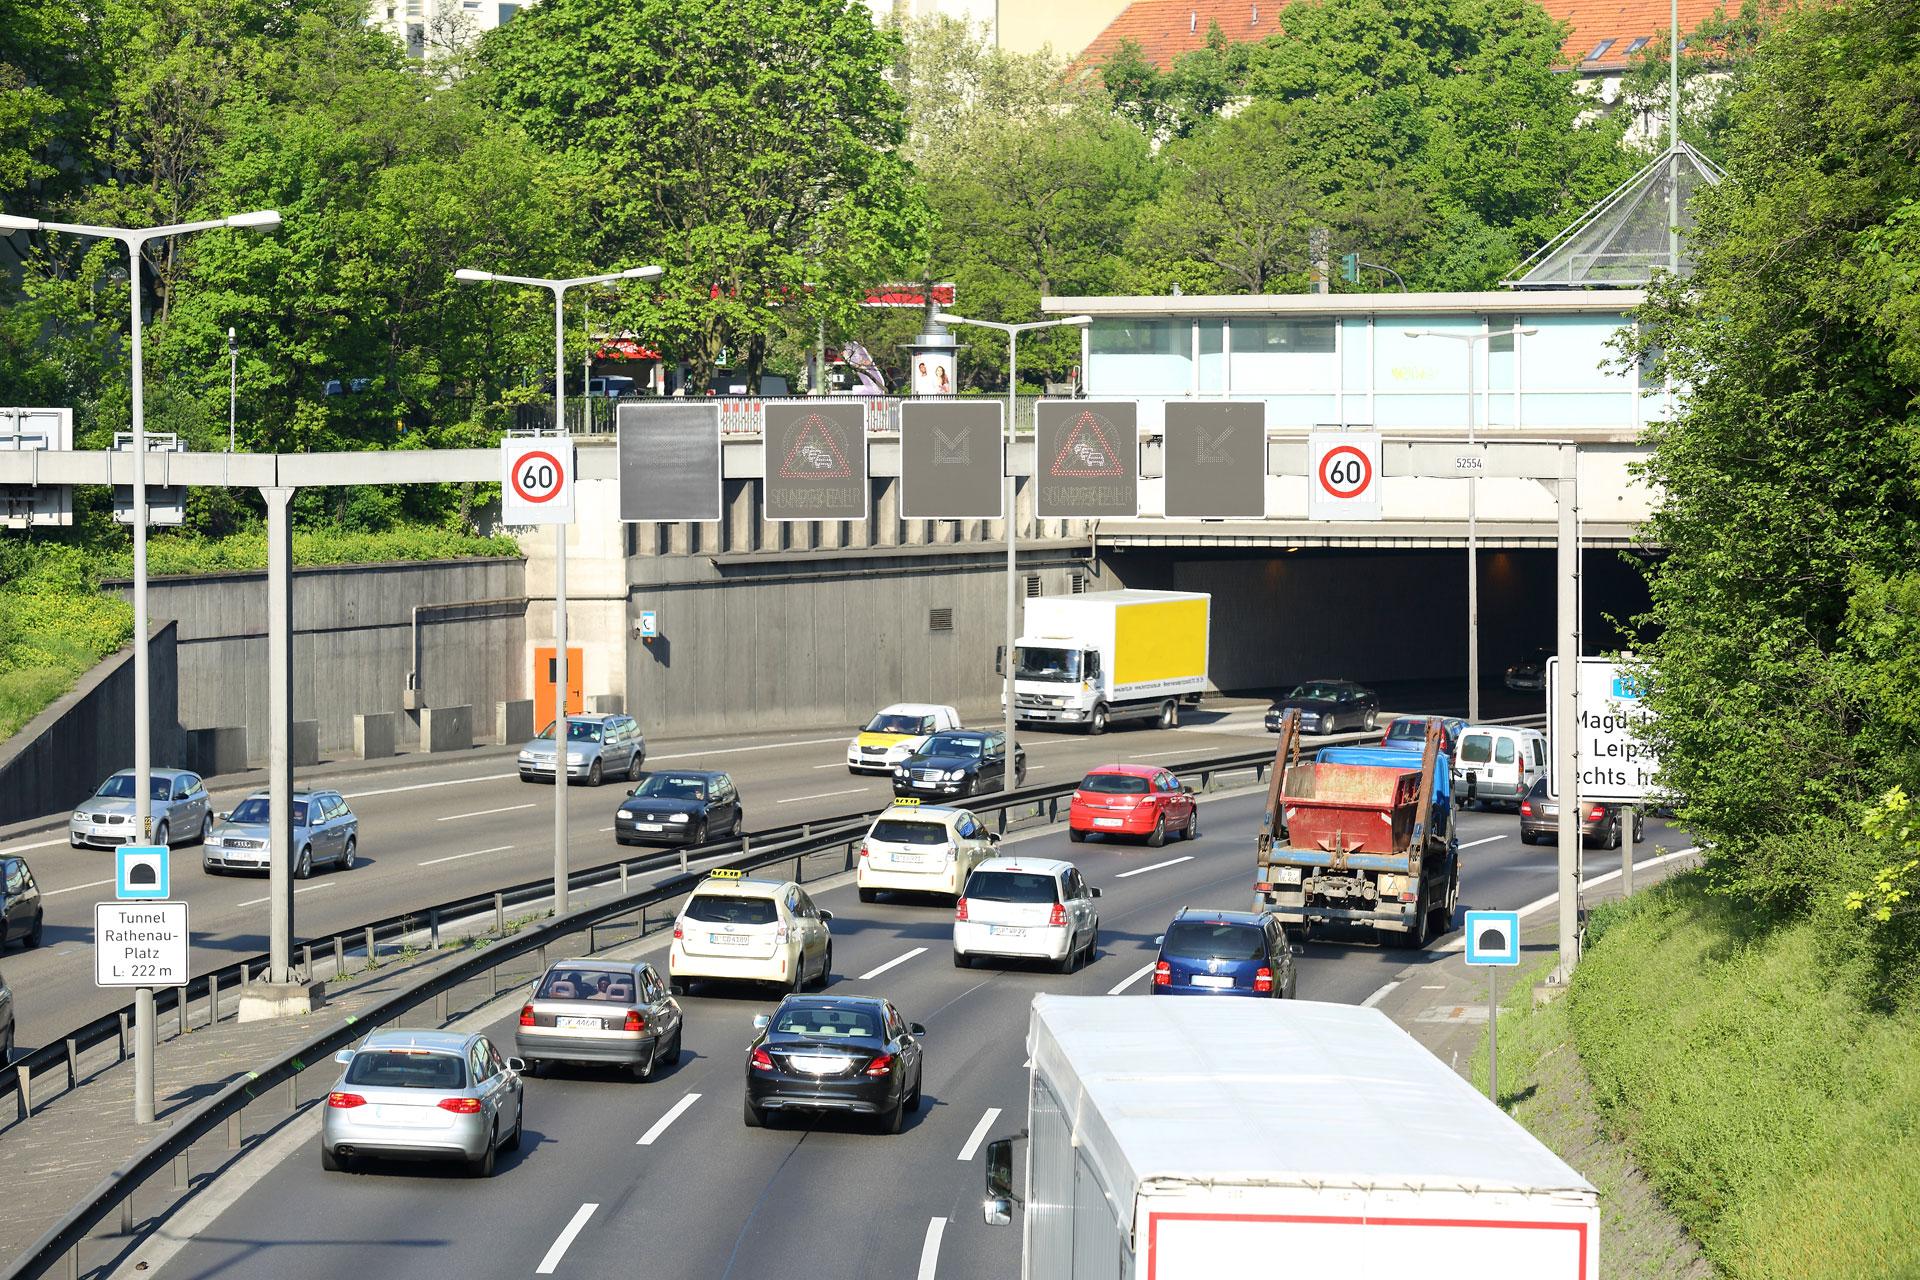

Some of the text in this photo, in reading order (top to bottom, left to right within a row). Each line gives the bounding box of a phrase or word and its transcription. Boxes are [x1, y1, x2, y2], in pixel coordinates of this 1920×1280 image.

[1456, 457, 1482, 469] 52554
[523, 465, 552, 489] 60
[1330, 460, 1361, 484] 60
[118, 911, 166, 924] Tunnel
[105, 930, 179, 942] Rathenau-
[124, 947, 160, 959] Platz
[131, 965, 156, 977] 222
[159, 967, 172, 977] m
